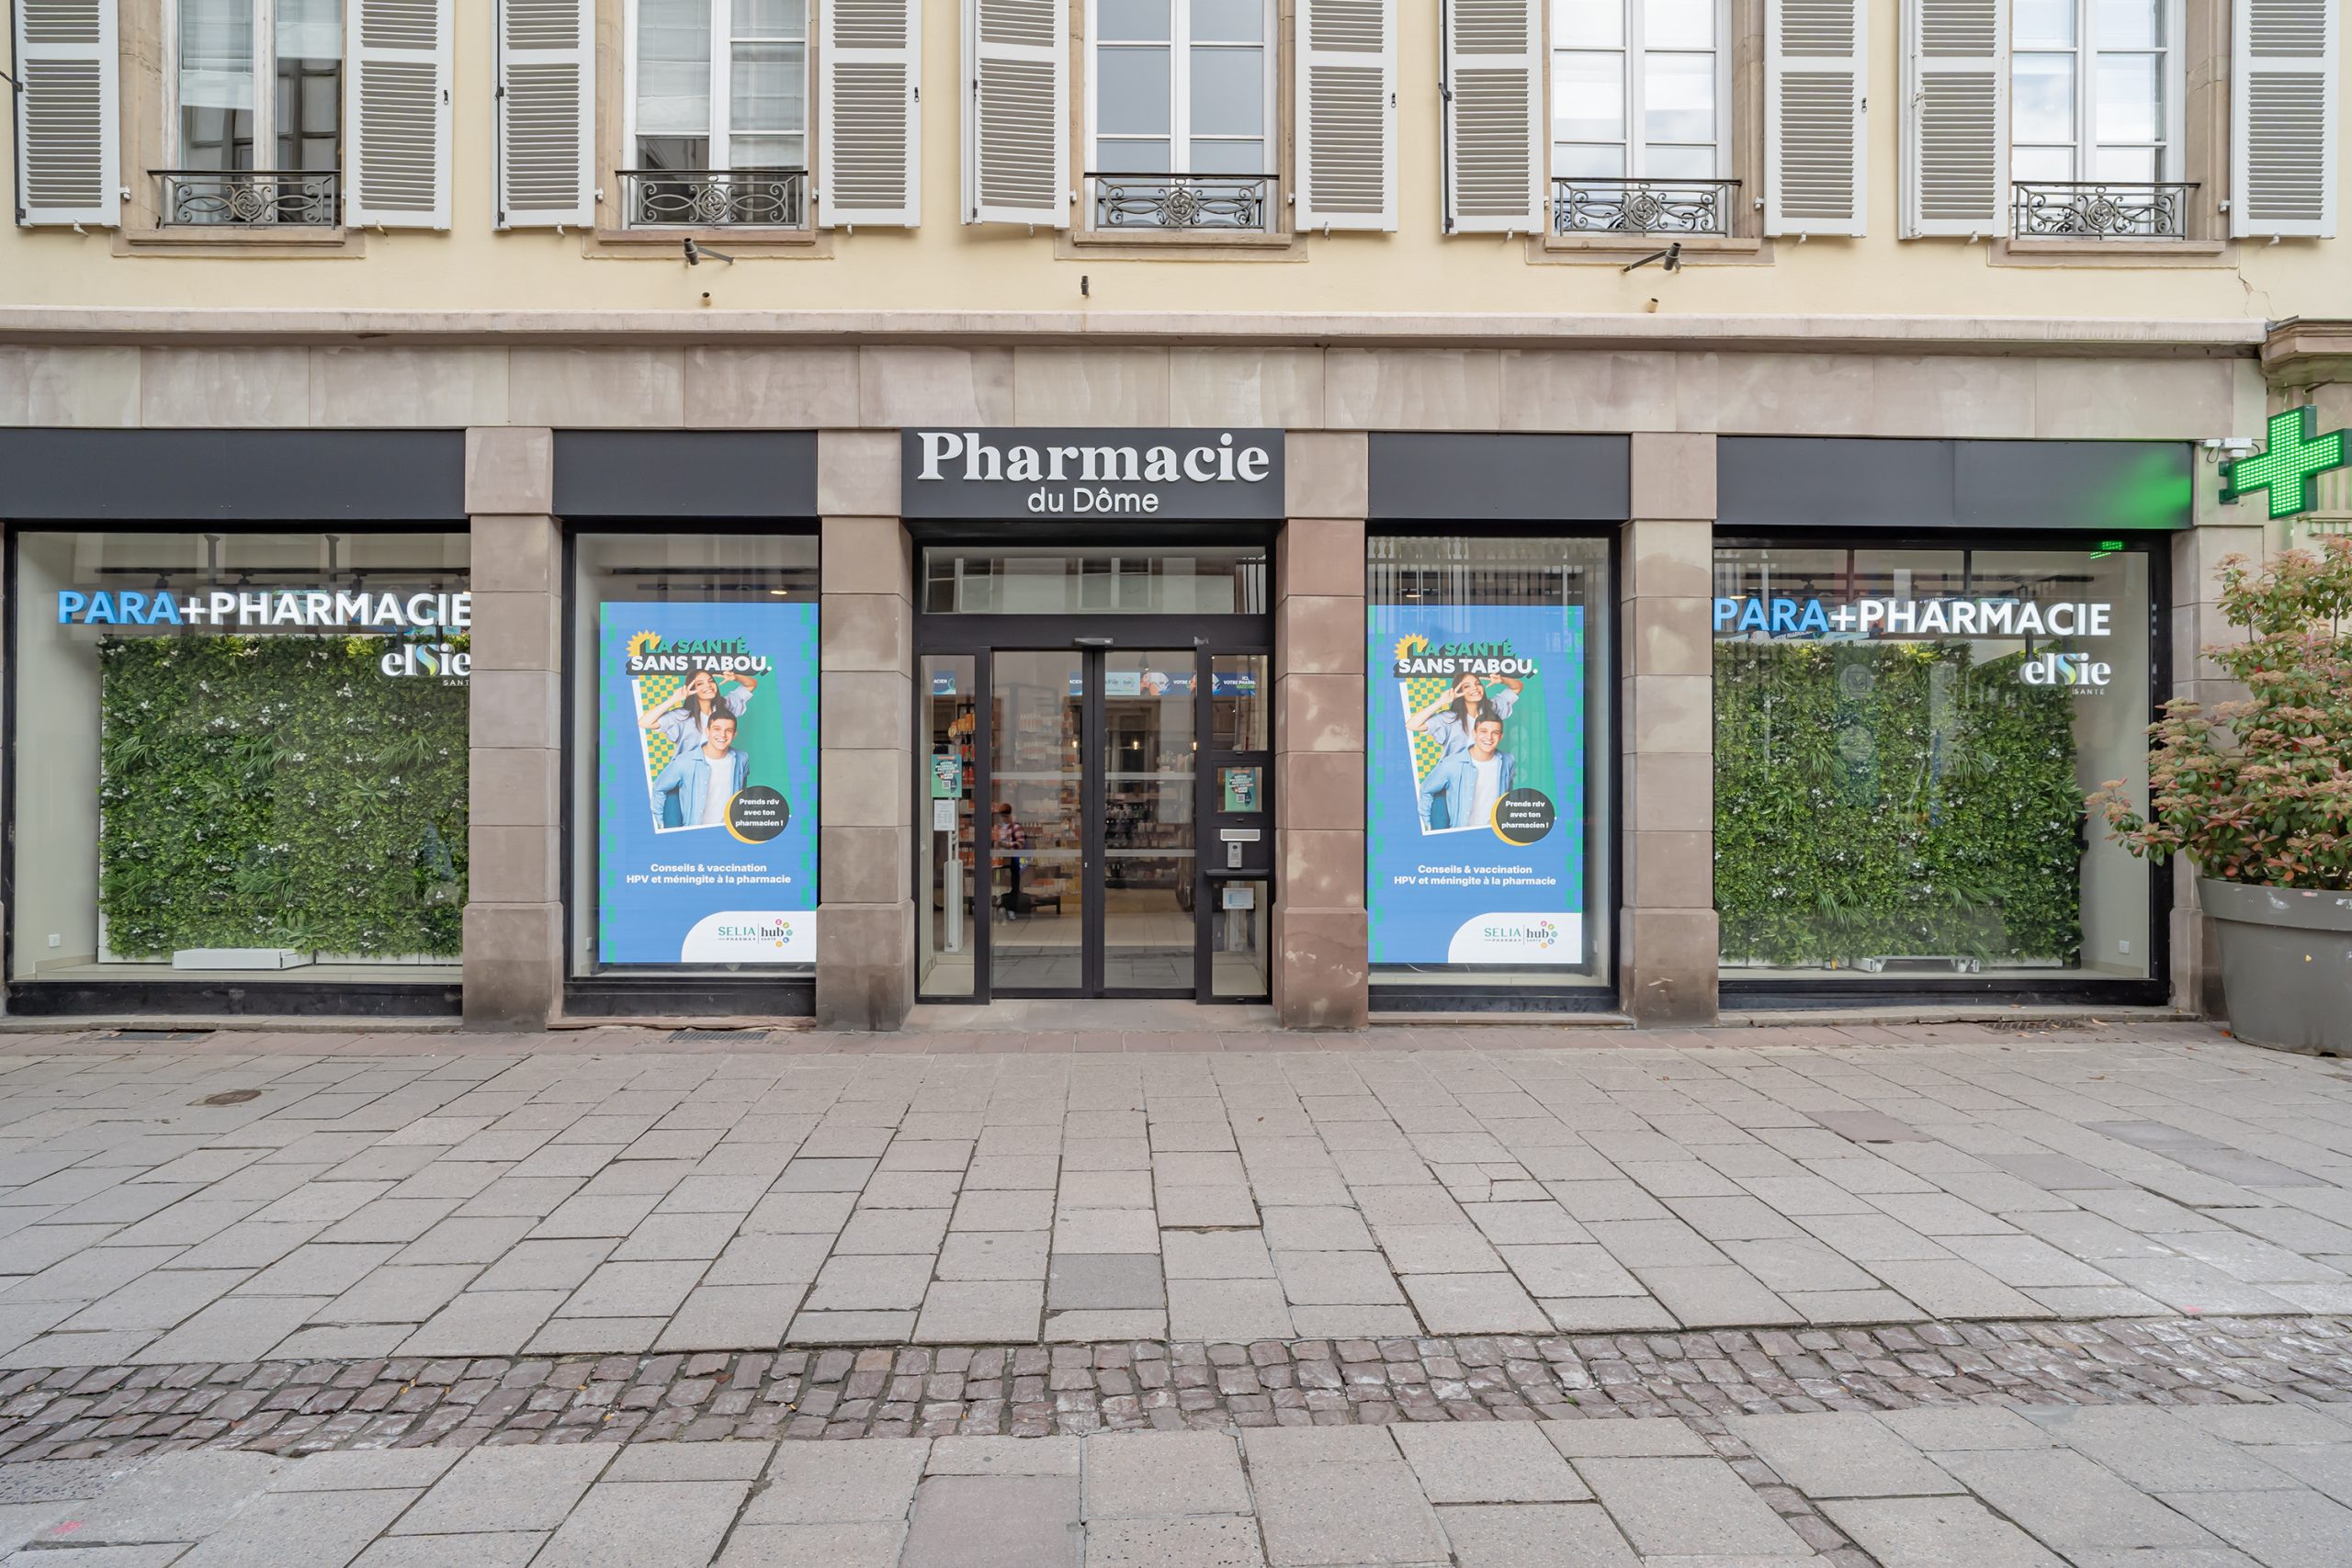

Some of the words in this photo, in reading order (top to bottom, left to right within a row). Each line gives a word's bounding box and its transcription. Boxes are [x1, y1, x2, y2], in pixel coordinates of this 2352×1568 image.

[918, 433, 1269, 481] Pharmacie
[1027, 487, 1064, 513] du
[1073, 487, 1159, 513] Dôme
[646, 639, 673, 653] LA
[1413, 641, 1440, 656] LA
[631, 655, 688, 671] SANS
[692, 656, 772, 671] TABOU.
[1398, 658, 1455, 674] SANS
[1459, 658, 1538, 674] TABOU.
[735, 819, 779, 828] pharmacien
[650, 863, 695, 873] Conseils
[697, 863, 704, 873] &
[707, 863, 767, 873] vaccination
[1418, 865, 1462, 874] Conseils
[1464, 865, 1471, 874] &
[1474, 865, 1532, 874] vaccination
[627, 875, 649, 884] HPV
[663, 874, 715, 886] méningite
[717, 874, 723, 884] à
[725, 875, 735, 884] la
[737, 875, 791, 886] pharmacie
[1394, 876, 1416, 885] HPV
[1419, 876, 1429, 885] et
[1430, 875, 1481, 886] méningite
[1483, 875, 1489, 885] à
[1491, 876, 1500, 885] la
[1502, 876, 1556, 886] pharmacie
[718, 927, 755, 936] SELIA
[761, 927, 784, 937] hub
[1485, 928, 1521, 937] SELIA
[1527, 928, 1549, 938] hub
